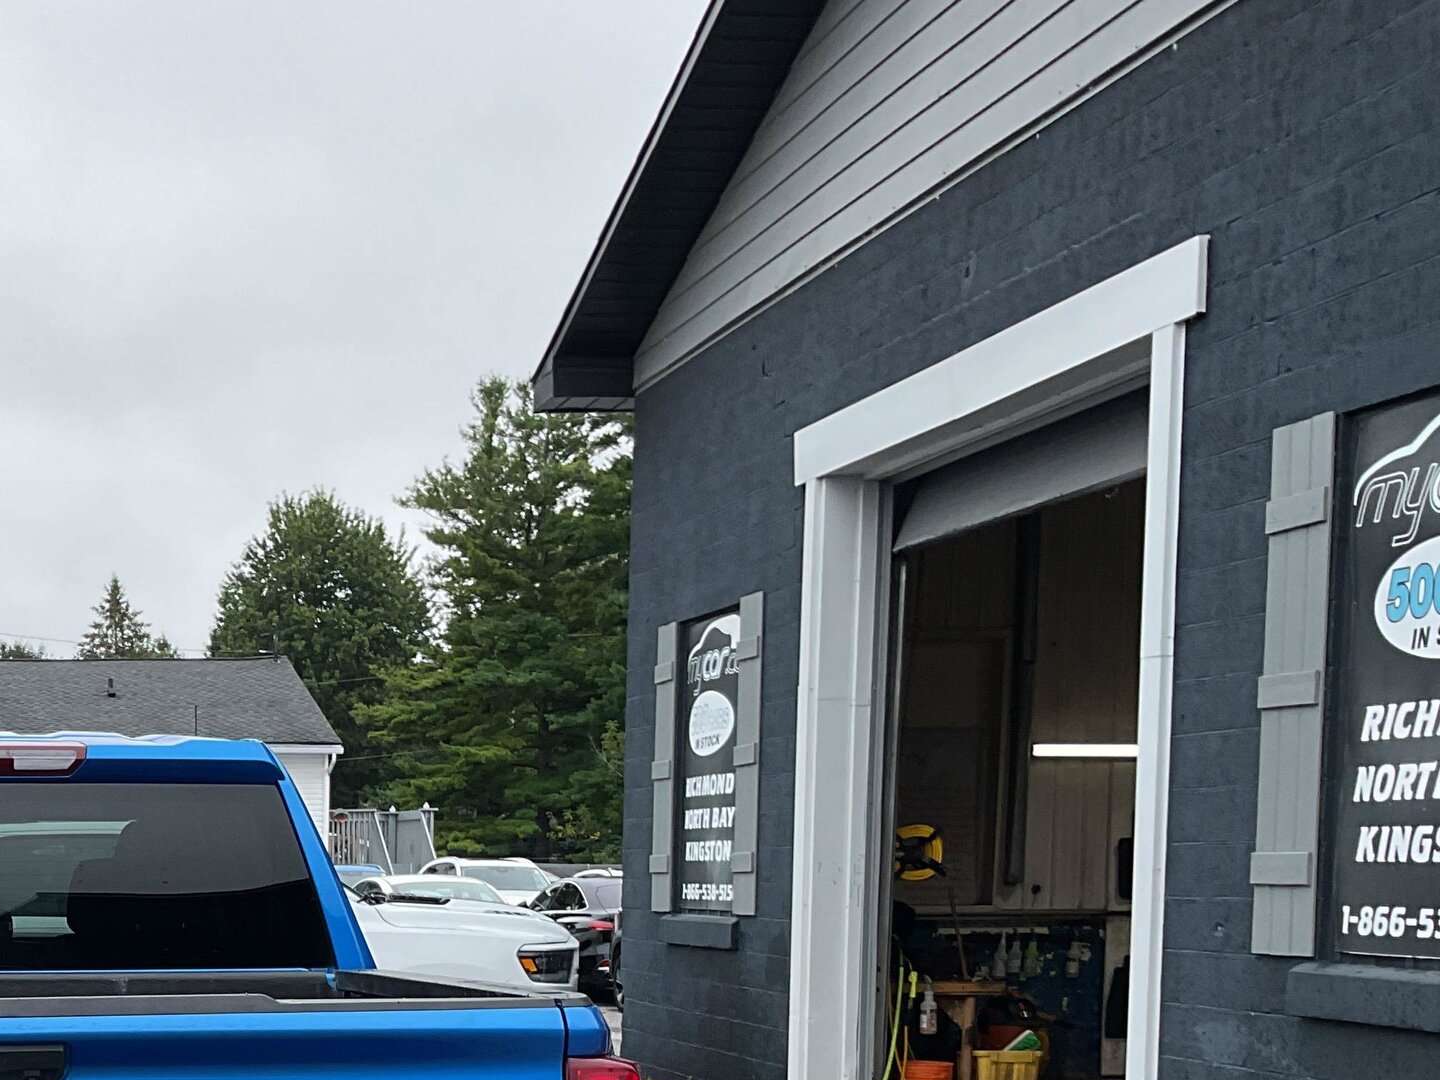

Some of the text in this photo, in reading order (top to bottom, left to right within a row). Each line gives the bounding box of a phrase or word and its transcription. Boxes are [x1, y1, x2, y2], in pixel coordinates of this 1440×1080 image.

[1386, 562, 1440, 623] 50
[1411, 627, 1431, 650] IN
[1360, 699, 1440, 742] RICH
[685, 772, 735, 798] RICHMOND
[684, 806, 736, 830] NORTH BAY
[685, 840, 732, 862] KINGSTON
